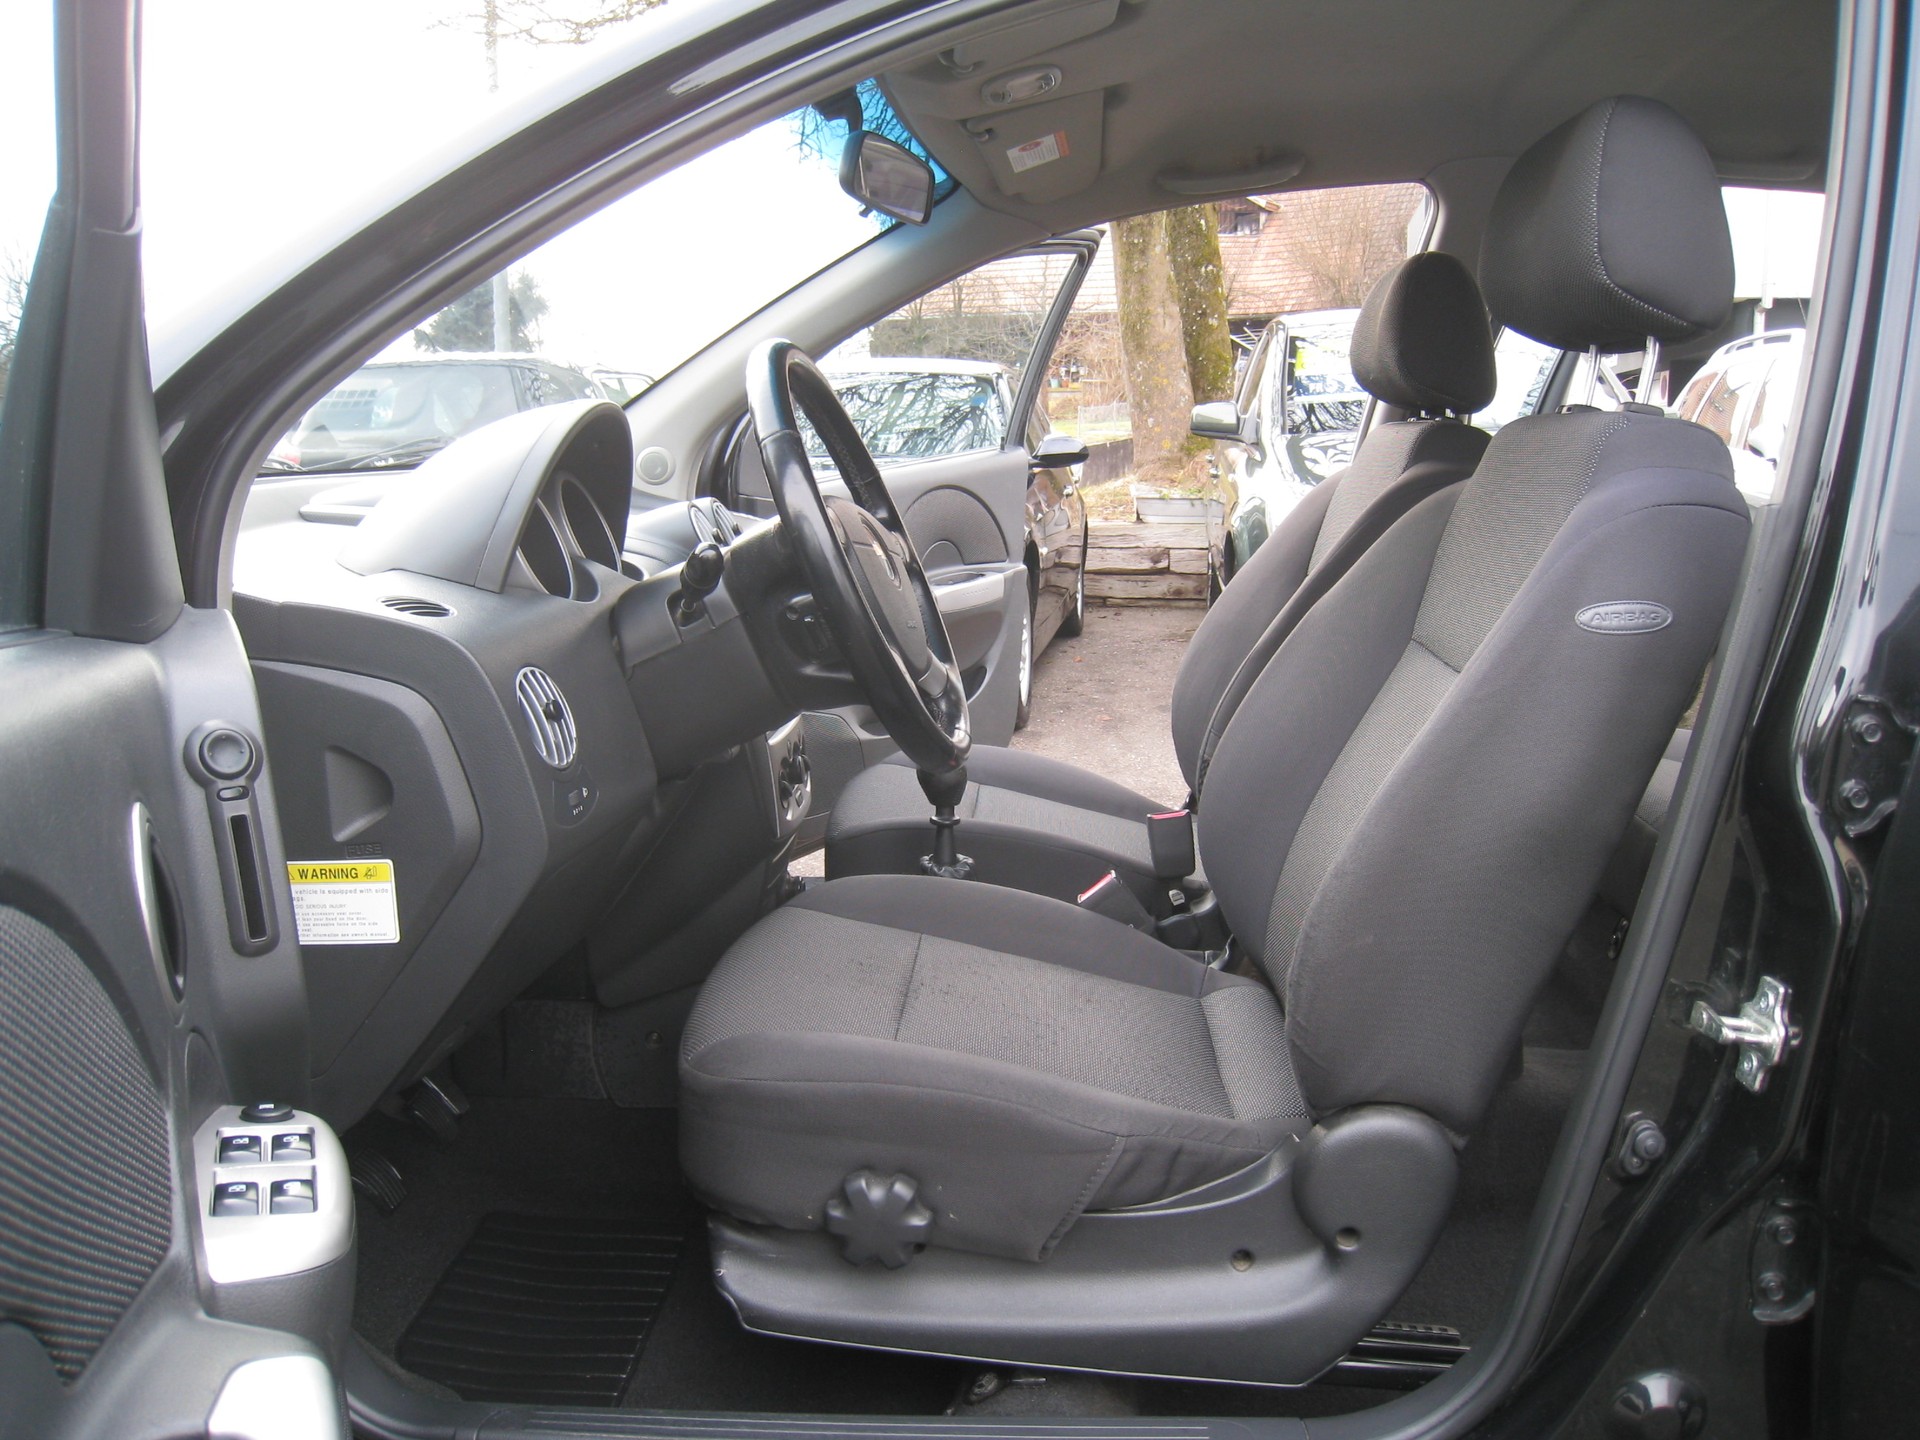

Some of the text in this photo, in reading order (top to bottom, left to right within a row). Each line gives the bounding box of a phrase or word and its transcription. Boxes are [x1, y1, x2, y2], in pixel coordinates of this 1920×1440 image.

[1590, 612, 1662, 625] AIRBAG
[347, 843, 382, 856] FUSE
[298, 868, 358, 880] WARNING
